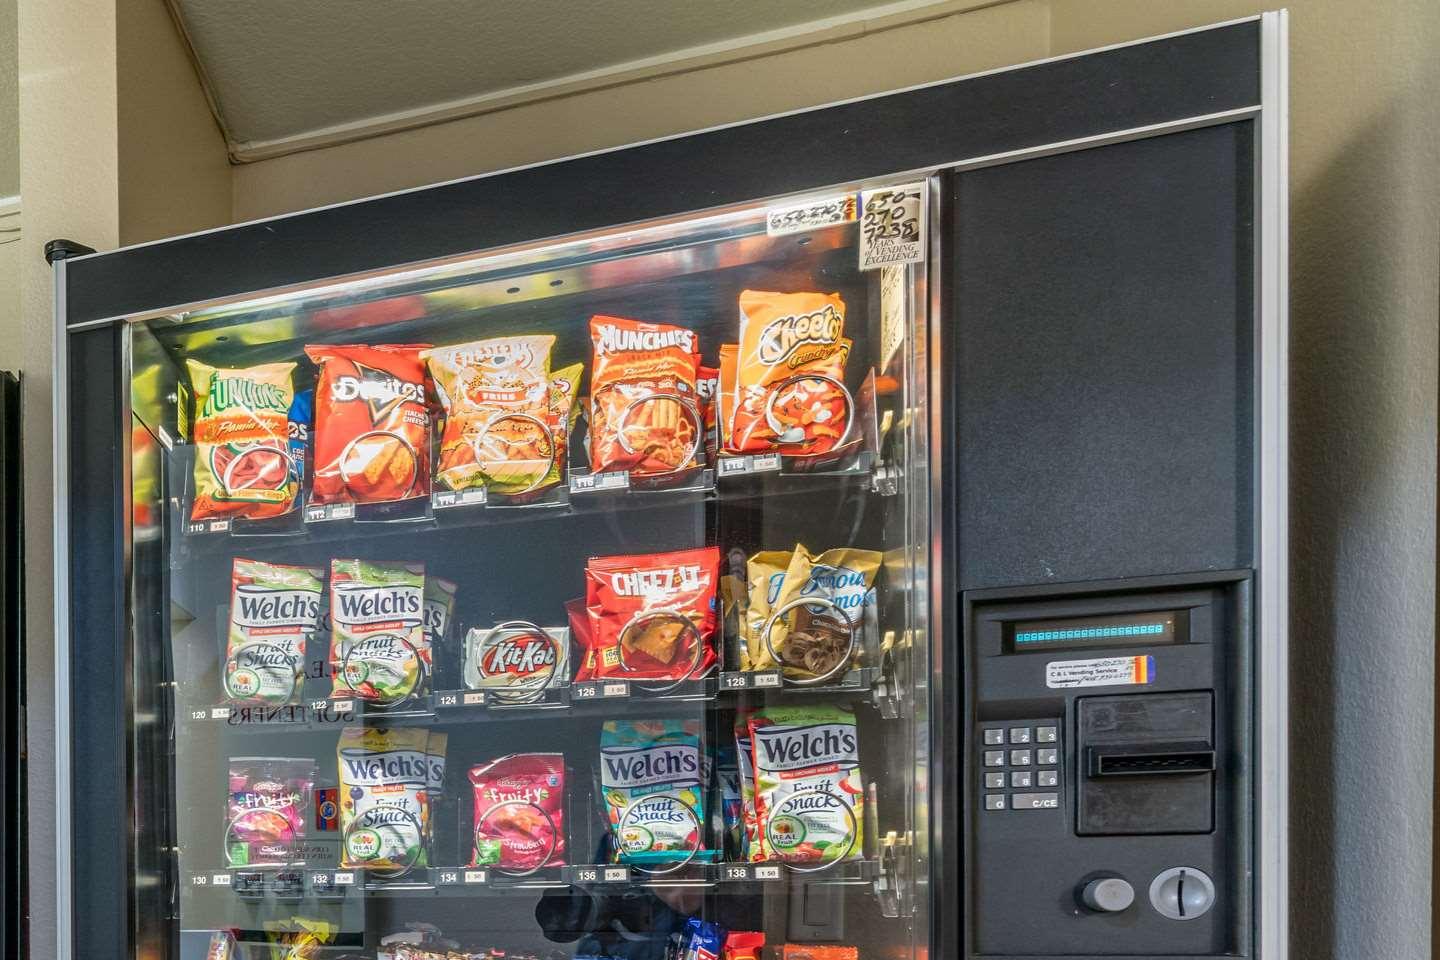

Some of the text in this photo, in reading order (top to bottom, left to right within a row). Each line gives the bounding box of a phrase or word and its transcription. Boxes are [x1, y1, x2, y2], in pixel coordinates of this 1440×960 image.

[865, 191, 906, 211] 650
[864, 206, 906, 229] 270
[865, 250, 918, 265] EXCELLENCE
[598, 324, 693, 353] MUNCHIES
[332, 377, 425, 402] Doritos
[190, 524, 204, 532] 110
[239, 594, 319, 620] Welch's
[339, 592, 420, 617] Welch's
[727, 678, 745, 686] 128
[577, 688, 595, 697] 126
[312, 701, 327, 710] 122
[441, 697, 456, 705] 124
[192, 712, 206, 720] 120
[761, 729, 855, 763] Welch's
[348, 756, 425, 782] Welch's
[606, 751, 697, 781] Welch's
[637, 799, 673, 813] Fruit
[1032, 800, 1057, 808] C/CE
[629, 809, 684, 823] Snacks
[312, 875, 328, 884] 132
[441, 873, 456, 882] 134
[579, 872, 595, 880] 136
[728, 869, 746, 877] 138
